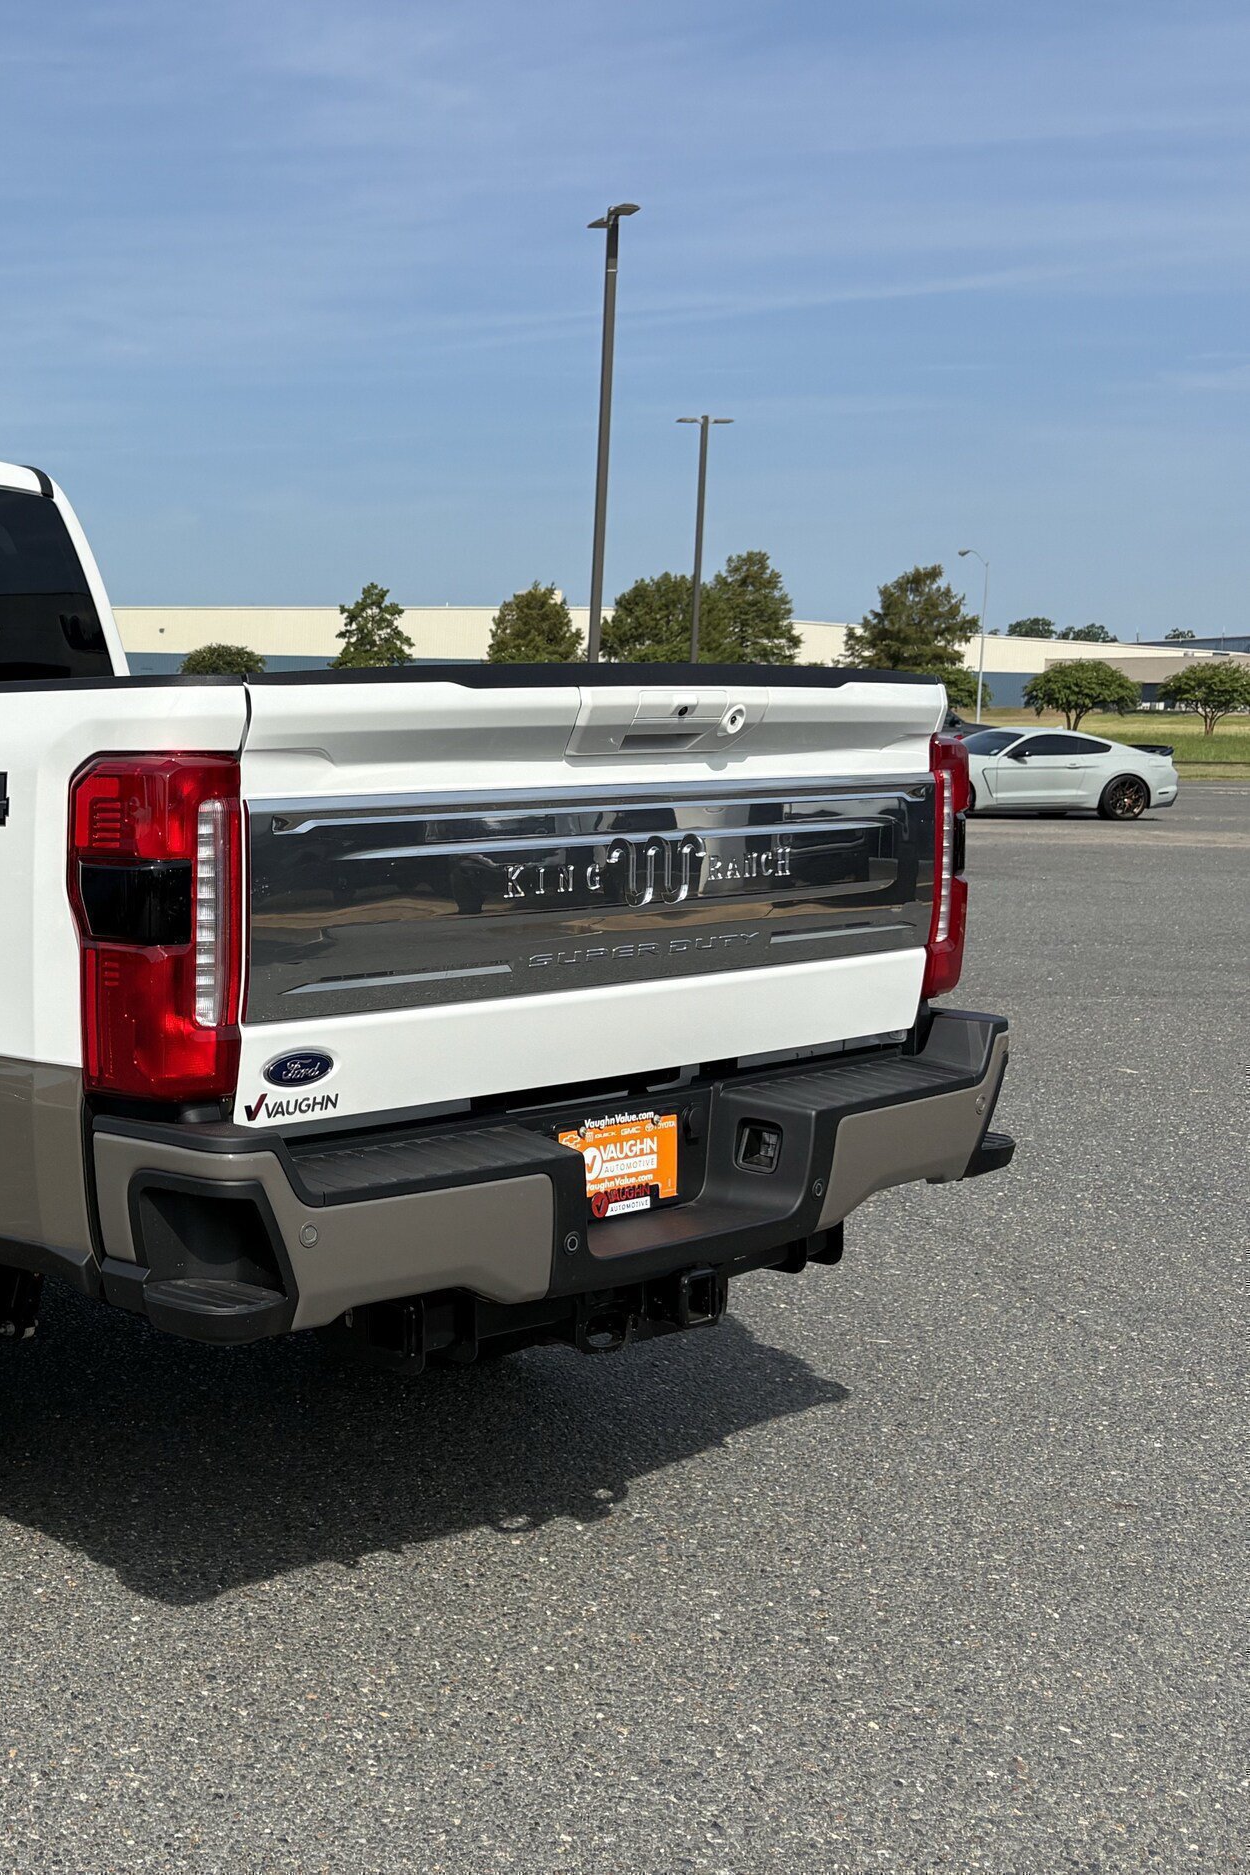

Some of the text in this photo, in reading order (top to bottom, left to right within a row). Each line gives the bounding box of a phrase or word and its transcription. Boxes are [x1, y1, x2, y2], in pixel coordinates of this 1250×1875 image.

[503, 846, 791, 899] KING RANCH
[528, 931, 760, 967] SUPER DUTY
[281, 1058, 321, 1081] Ford
[265, 1093, 338, 1119] VAUGHN
[584, 1111, 655, 1130] VaughnValue.com
[620, 1125, 642, 1136] GMC
[600, 1136, 658, 1160] VAUGHN
[604, 1157, 655, 1174] AUTOMOTIVE
[606, 1183, 651, 1203] VAUGHN
[610, 1199, 649, 1213] AUTOMOTIVE
